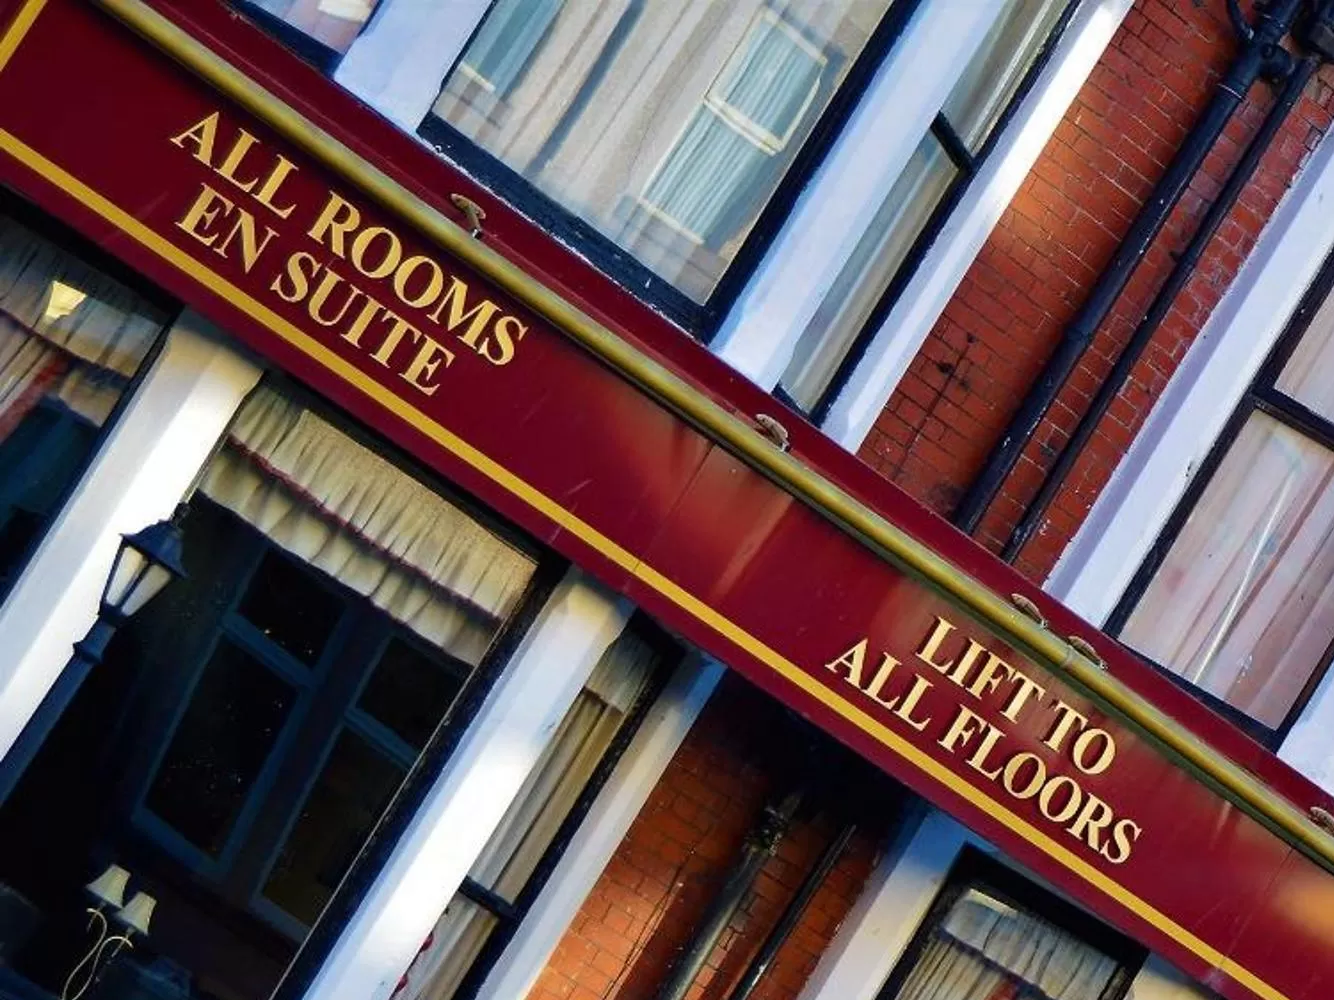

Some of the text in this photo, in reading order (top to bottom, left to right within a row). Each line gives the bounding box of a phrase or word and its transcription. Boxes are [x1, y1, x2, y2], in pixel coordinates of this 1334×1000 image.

[169, 111, 529, 366] ALL ROOMS
[175, 183, 456, 396] EN SUITE
[824, 638, 1142, 864] ALL FLOORS
[915, 615, 1116, 775] LIFT TO
